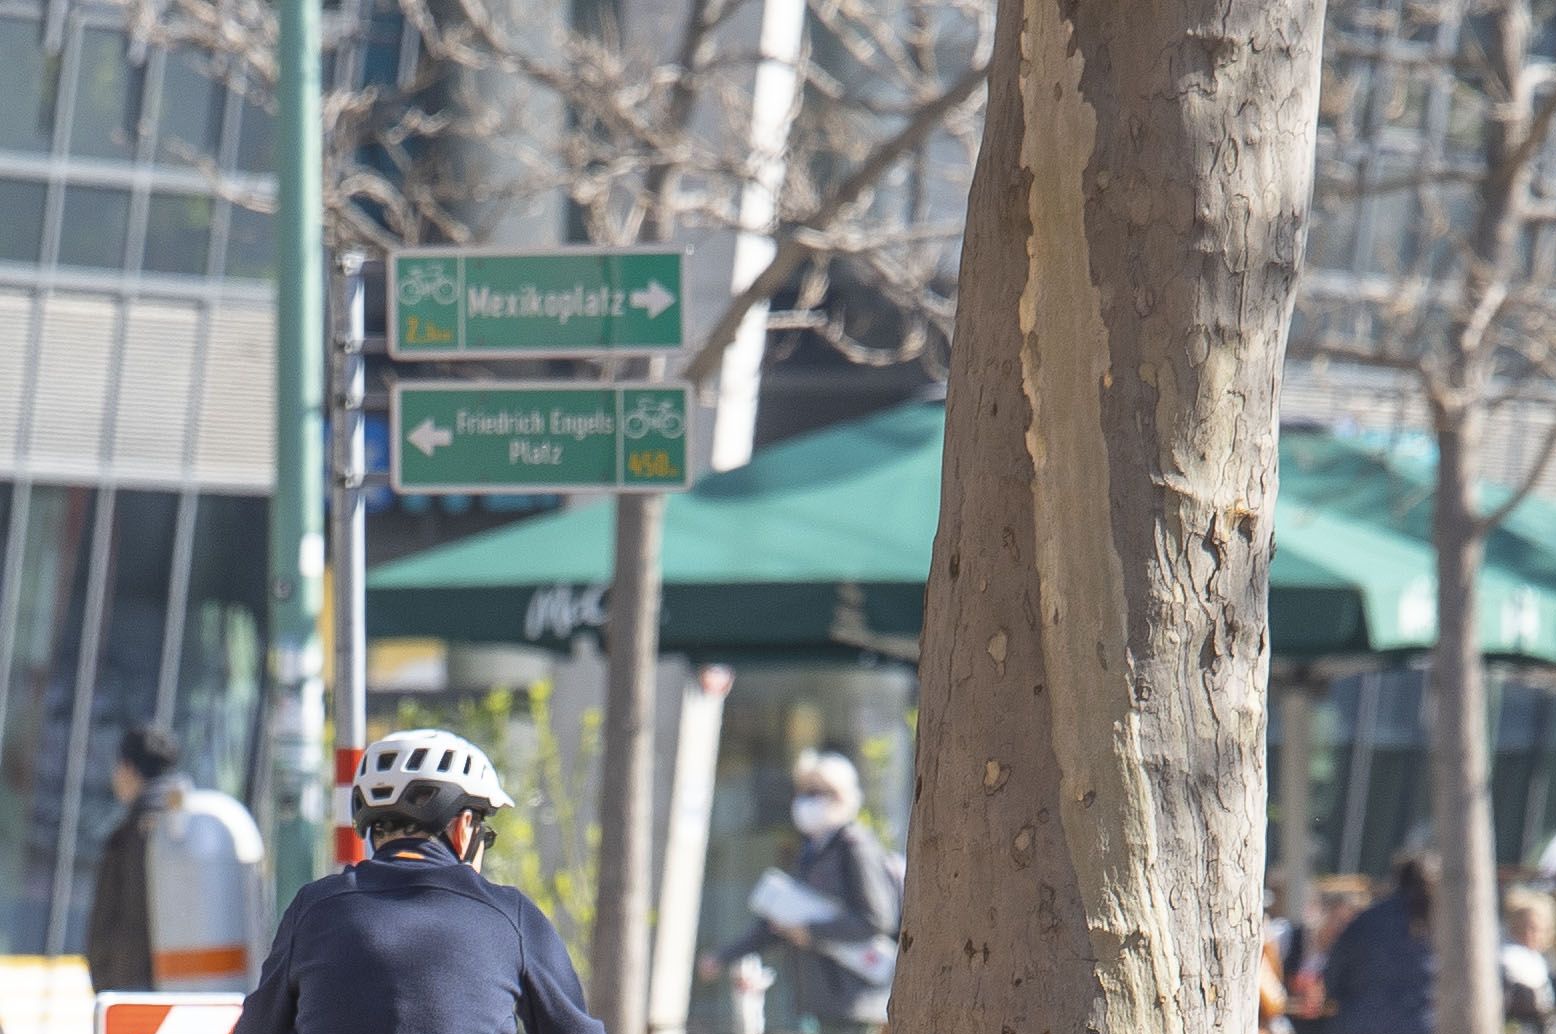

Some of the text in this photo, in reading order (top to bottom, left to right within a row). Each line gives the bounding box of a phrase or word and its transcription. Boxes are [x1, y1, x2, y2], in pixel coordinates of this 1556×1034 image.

[467, 284, 625, 325] Mexikoplatz
[455, 409, 615, 441] Friedrich Engels
[508, 439, 564, 465] Platz
